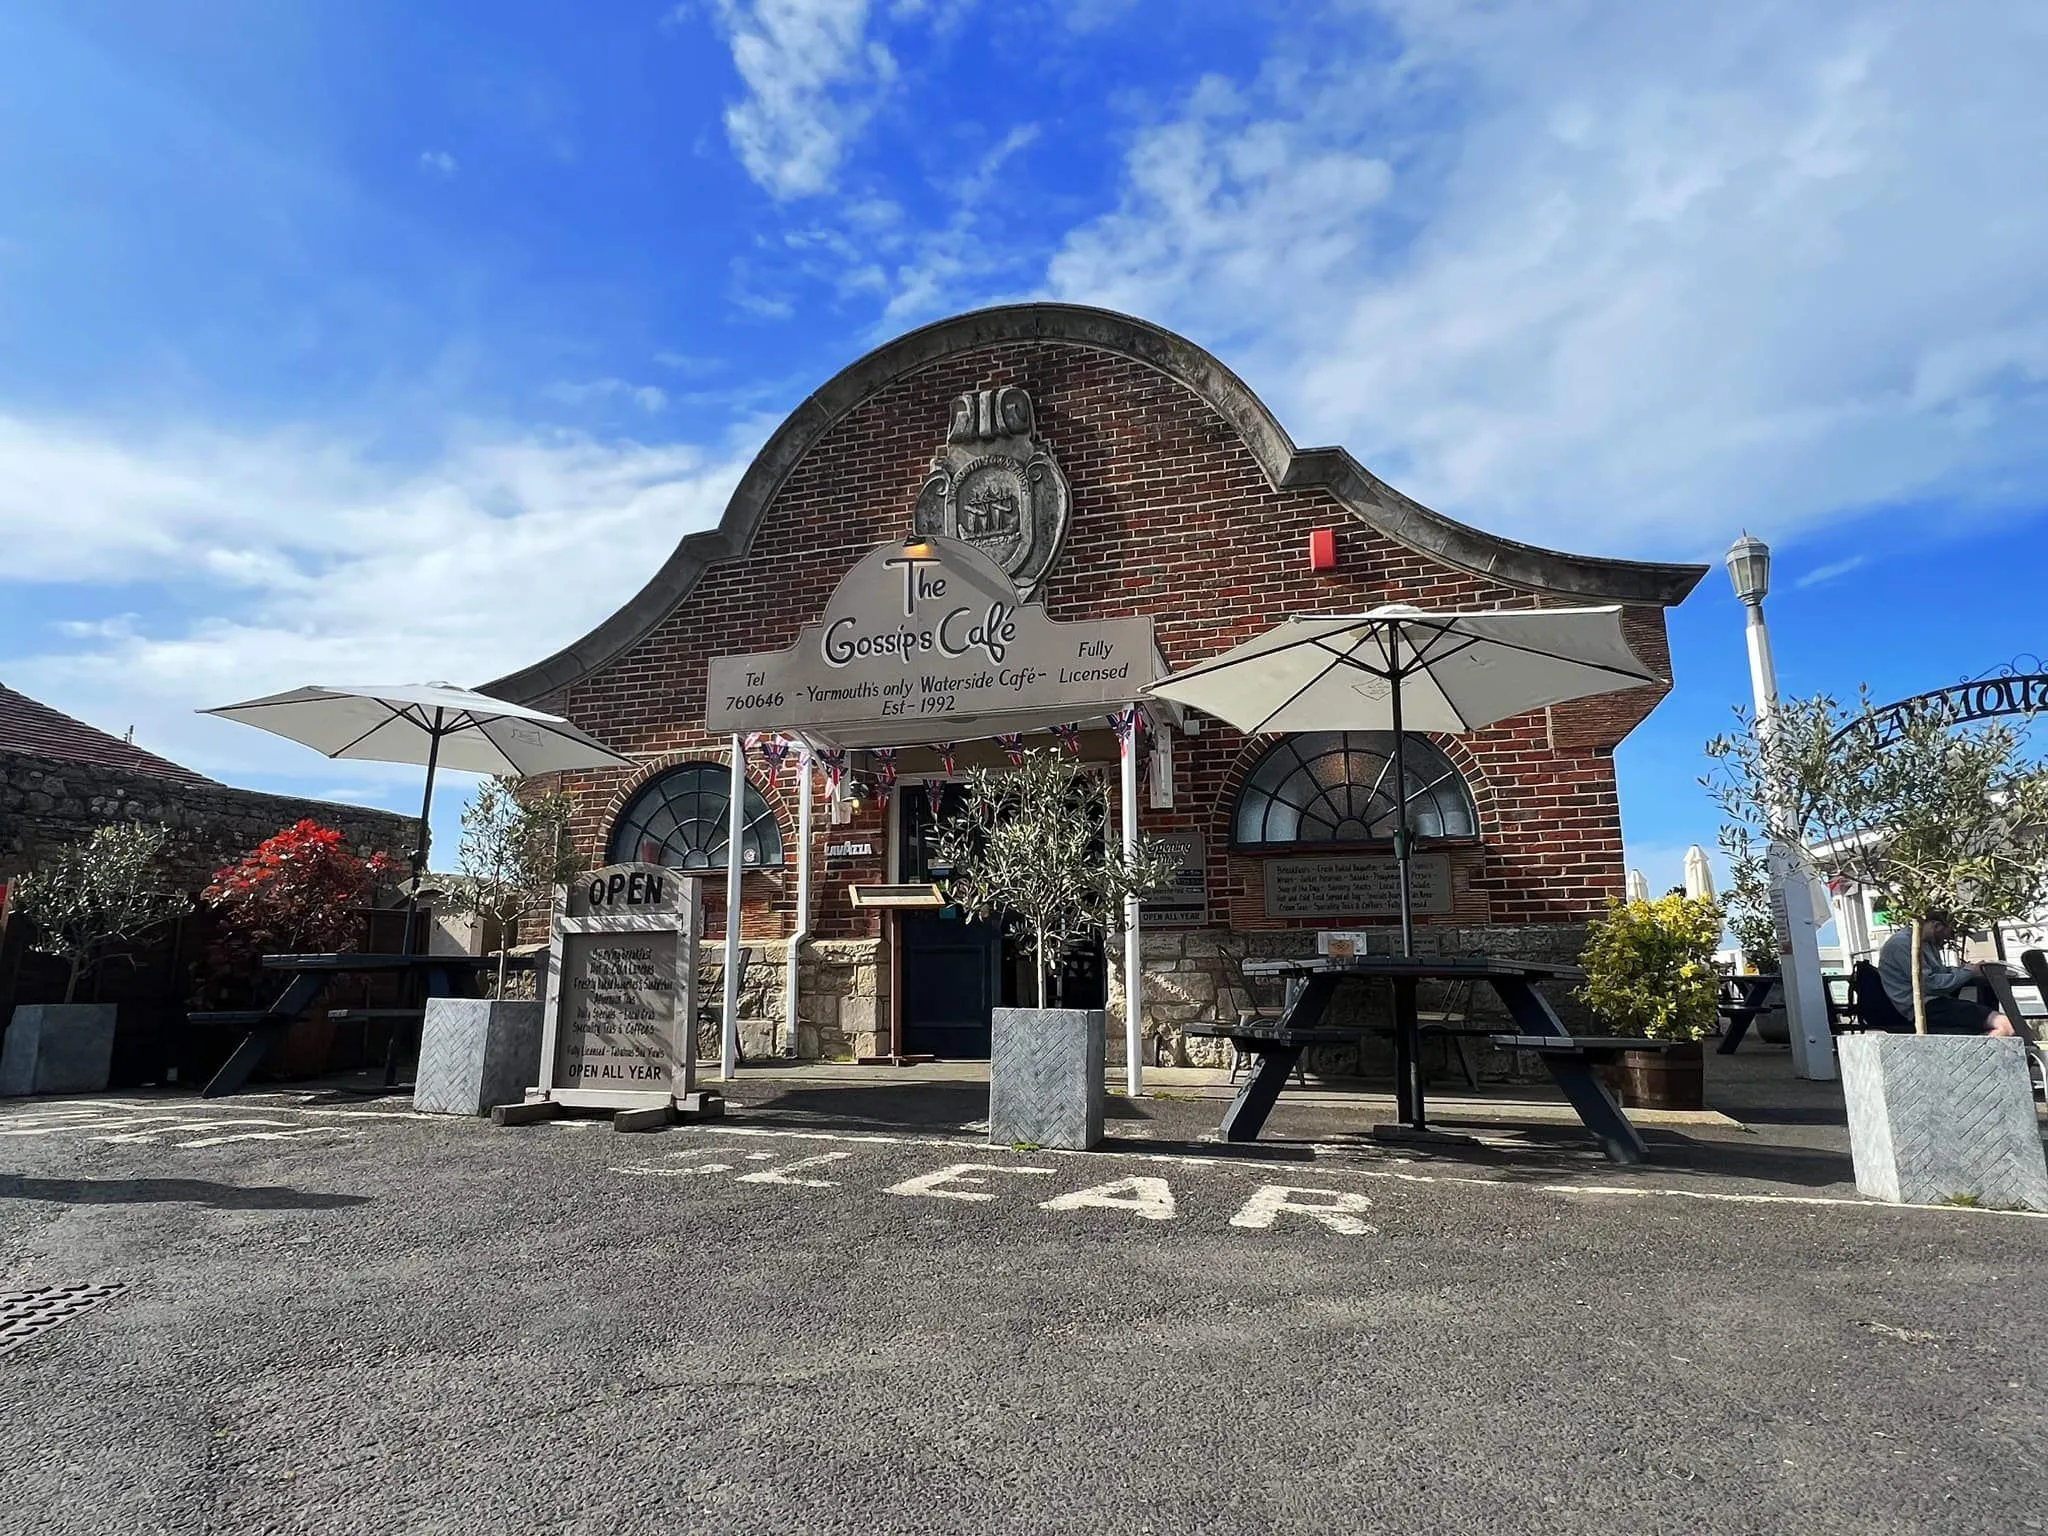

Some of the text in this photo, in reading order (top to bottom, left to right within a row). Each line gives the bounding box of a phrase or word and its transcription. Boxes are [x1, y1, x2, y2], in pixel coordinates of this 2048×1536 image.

[882, 558, 948, 616] The
[823, 600, 1017, 668] Gossips Café
[1078, 641, 1114, 659] Fully
[746, 672, 765, 687] Tel
[1059, 663, 1128, 684] Licensed
[883, 677, 914, 700] only
[920, 672, 994, 694] Waterside
[726, 692, 784, 711] 760646
[920, 696, 956, 714] 1992
[825, 841, 872, 856] LAVAZZA
[588, 871, 664, 905] OPEN
[1180, 912, 1200, 920] YEAR
[569, 1064, 661, 1079] OPEN ALL YEAR
[608, 1147, 1380, 1235] CLEAR
